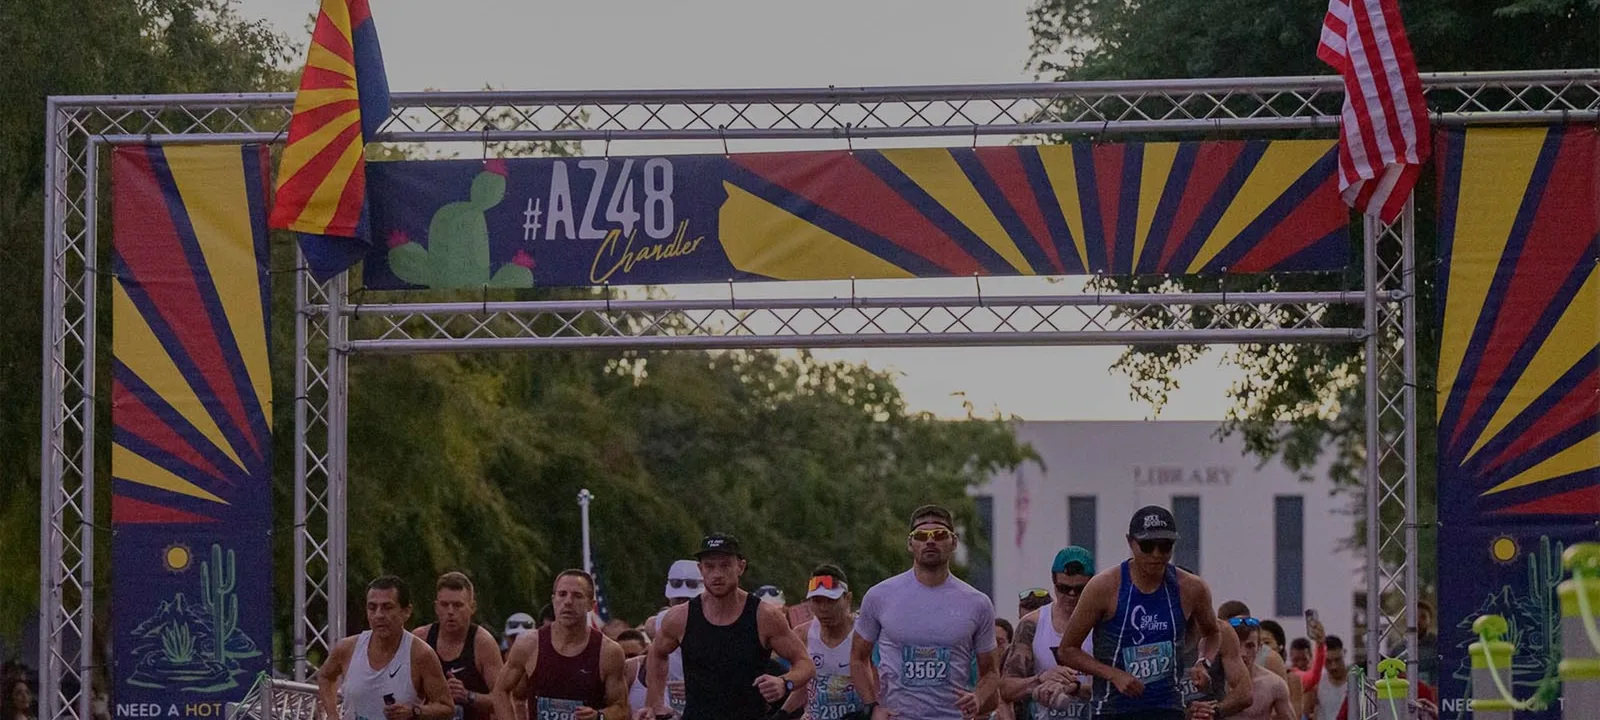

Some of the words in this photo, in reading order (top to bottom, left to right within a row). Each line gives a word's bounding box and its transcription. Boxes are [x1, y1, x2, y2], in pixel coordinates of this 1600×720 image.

[523, 157, 674, 241] #AZ48
[590, 219, 705, 284] Chandler
[1133, 466, 1235, 486] LIBRARY
[1140, 614, 1159, 623] SOLE
[1140, 621, 1168, 632] SPORTS
[904, 661, 947, 679] 3562
[1129, 656, 1170, 679] 2812
[116, 703, 162, 717] NEED
[167, 703, 180, 717] A
[185, 703, 222, 717] HOT
